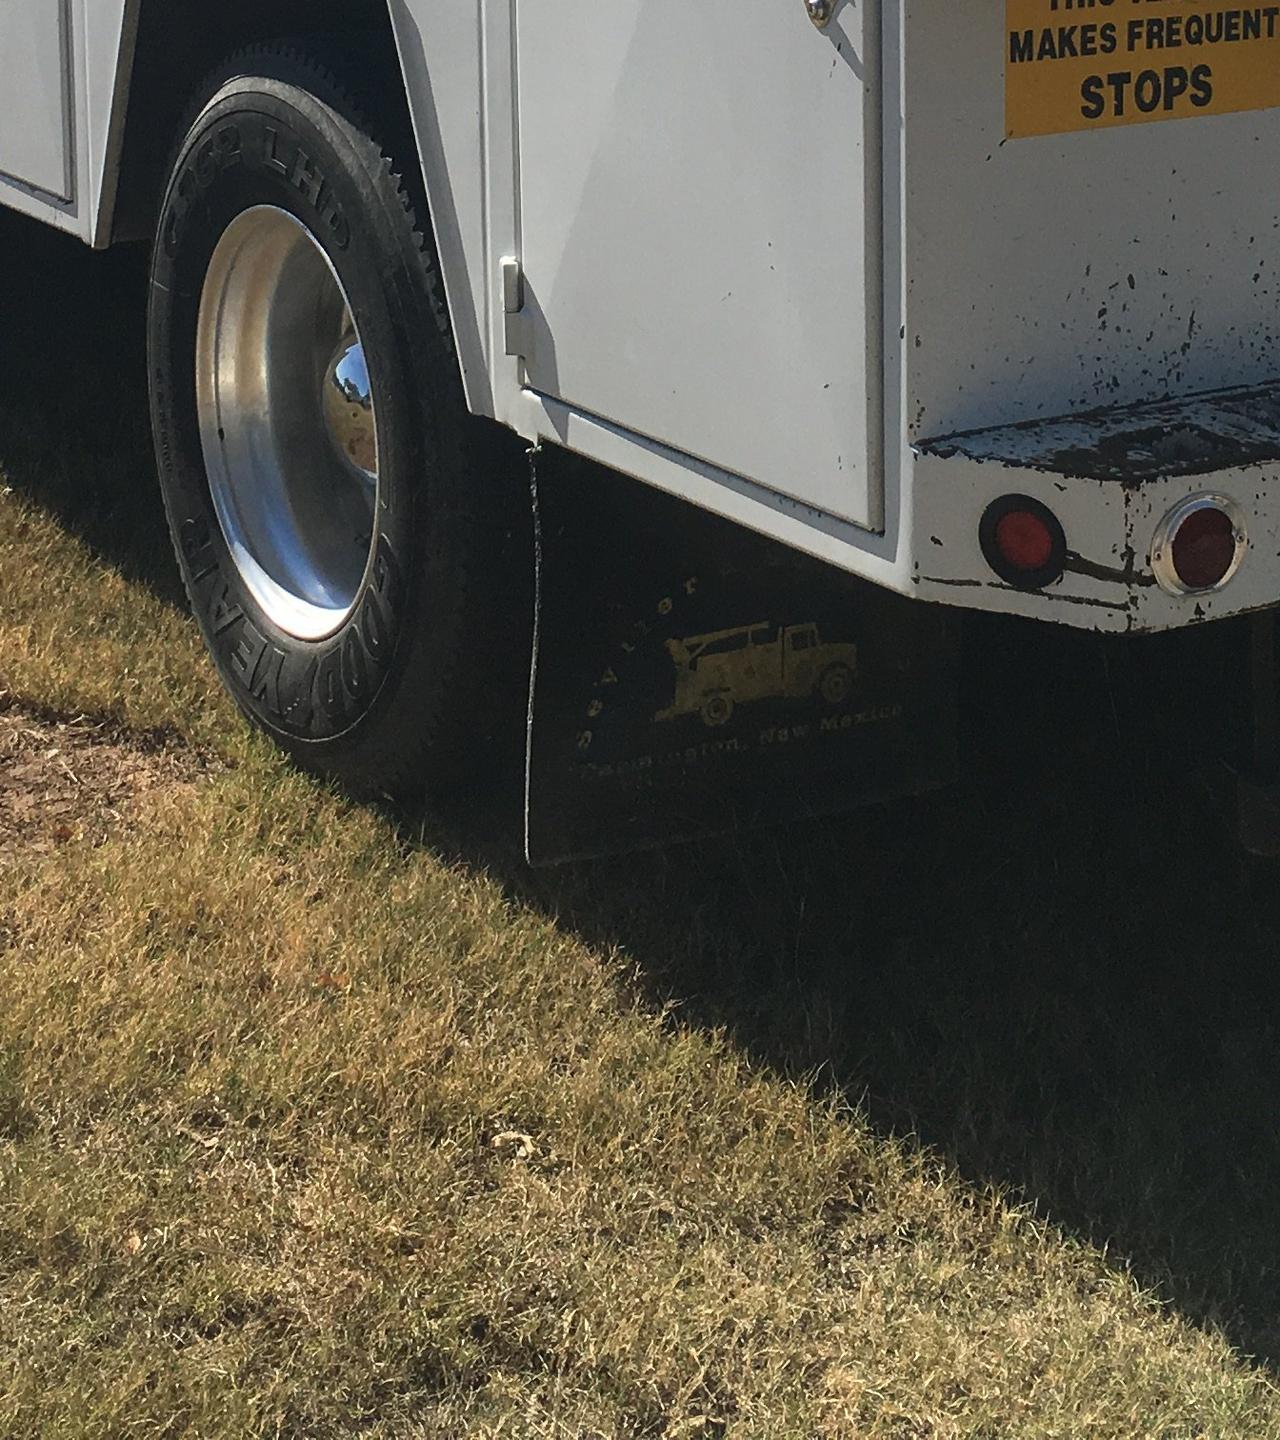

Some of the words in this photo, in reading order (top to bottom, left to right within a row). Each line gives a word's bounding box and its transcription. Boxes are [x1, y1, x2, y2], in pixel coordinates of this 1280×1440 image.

[1009, 22, 1116, 63] MAKES
[1127, 7, 1279, 52] FREQUENT
[1080, 63, 1213, 119] STOPS
